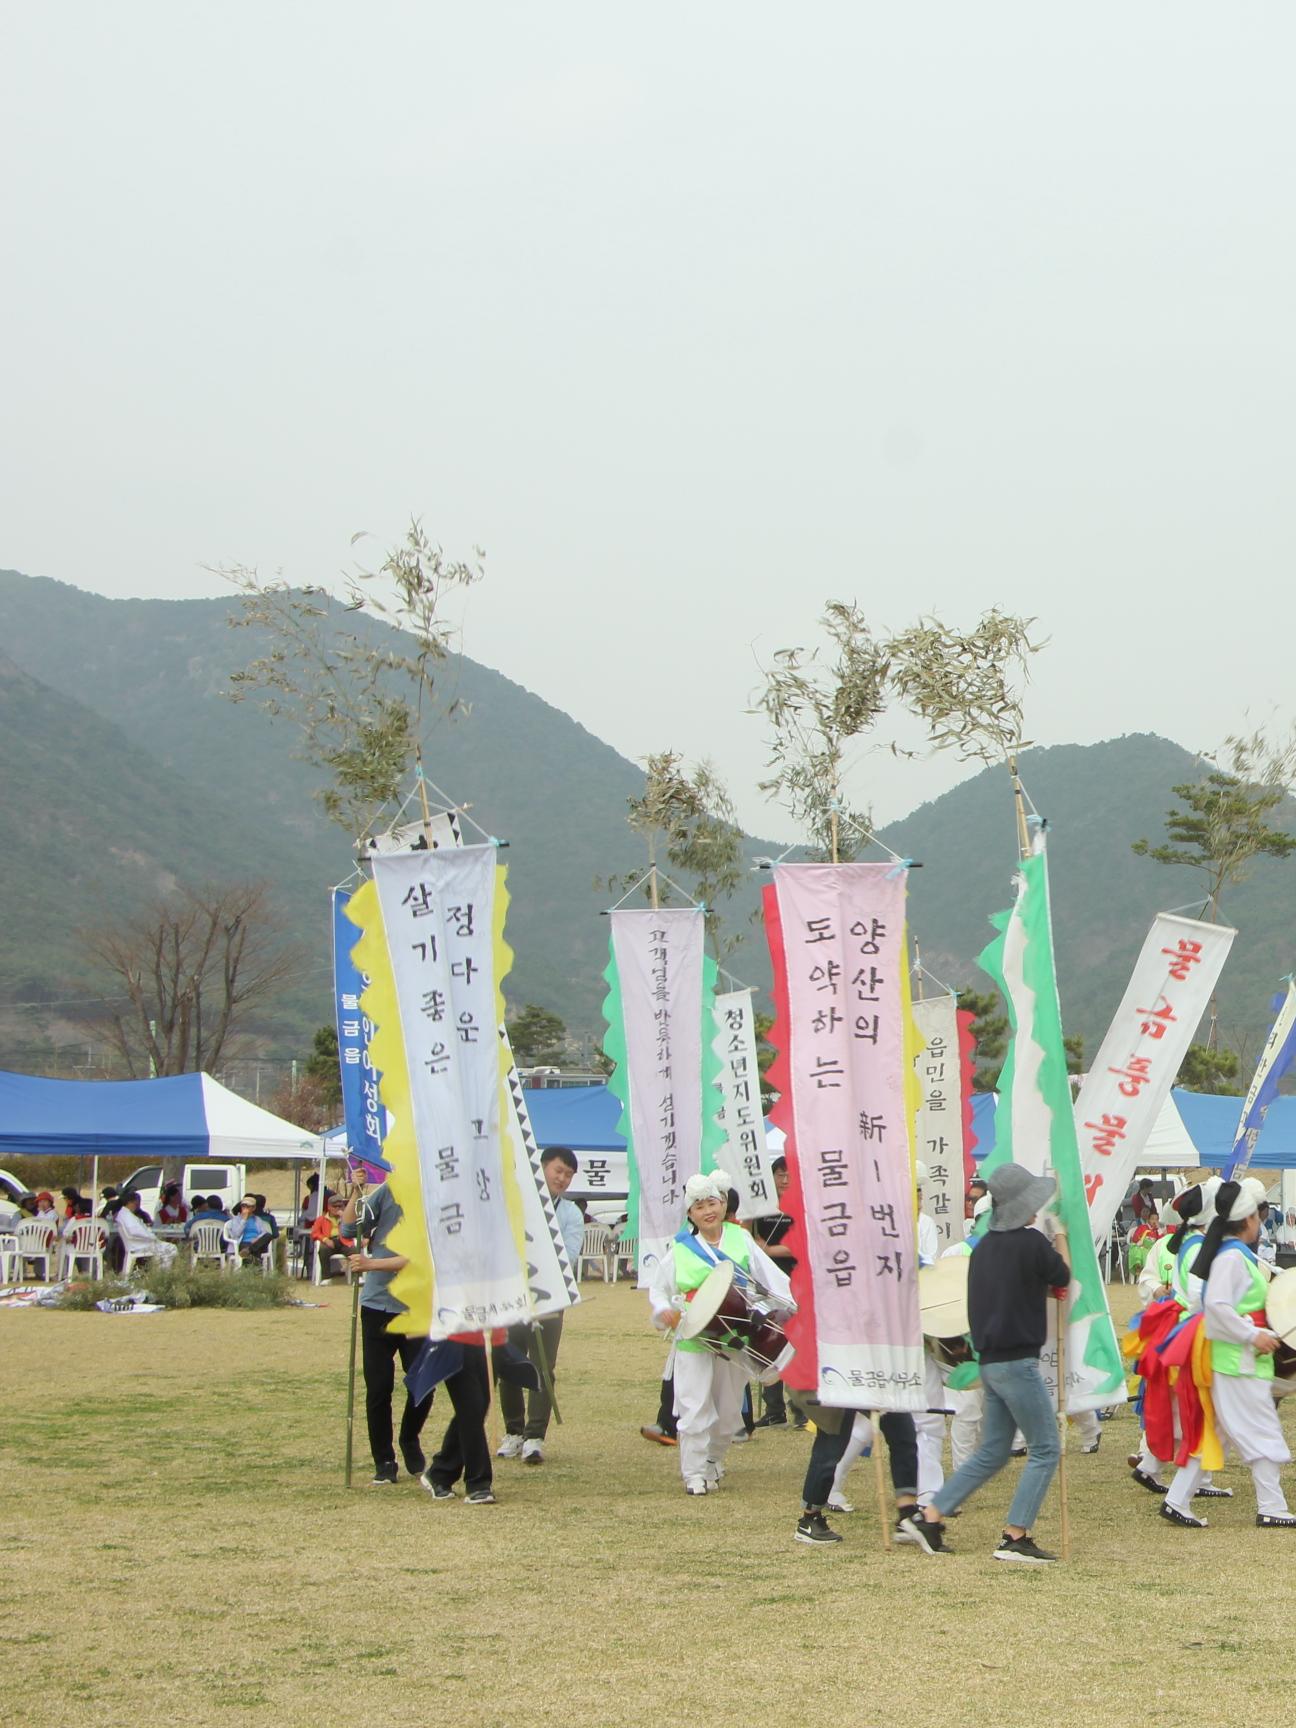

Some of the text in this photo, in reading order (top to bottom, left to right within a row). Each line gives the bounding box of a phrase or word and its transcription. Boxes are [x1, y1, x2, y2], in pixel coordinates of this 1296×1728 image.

[341, 994, 361, 1064] 물금읍
[446, 903, 479, 1042] 정다운
[850, 918, 886, 1045] 양산의
[724, 1008, 768, 1201] 청소년지도위원회
[805, 917, 856, 1287] 도약하는 물금읍
[925, 1036, 951, 1239] 읍민을 가족같이
[435, 1146, 464, 1234] 물금
[583, 1160, 611, 1187] 물
